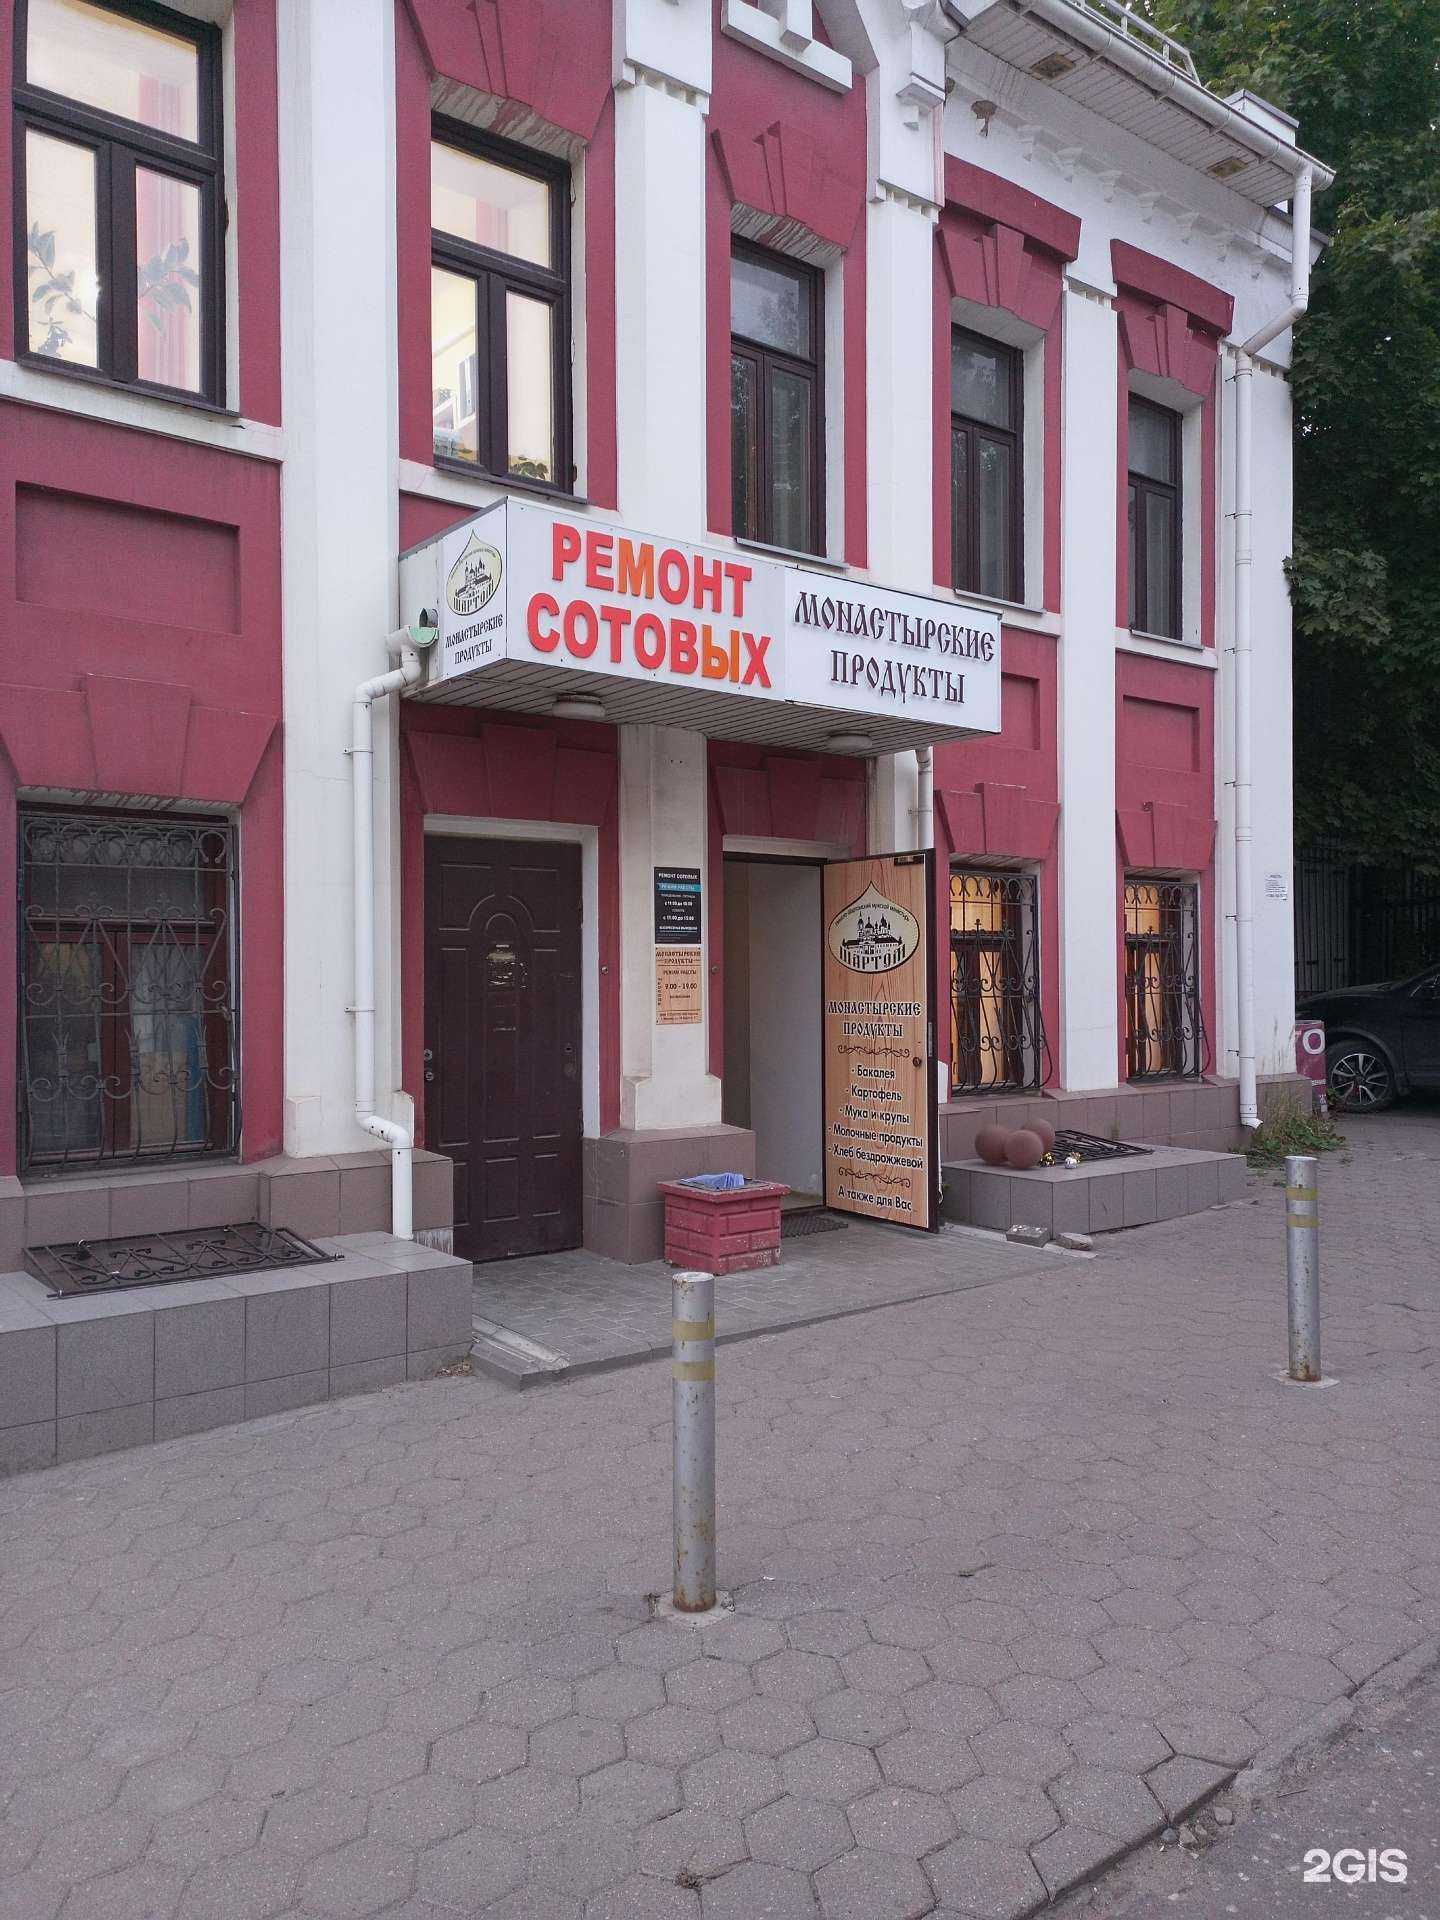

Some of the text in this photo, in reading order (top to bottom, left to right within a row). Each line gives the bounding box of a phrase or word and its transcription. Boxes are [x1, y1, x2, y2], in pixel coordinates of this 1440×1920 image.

[552, 522, 752, 618] РЕМОНТ
[445, 614, 503, 648] МОНАСТЫРСКИЕ
[794, 591, 995, 663] МОНАСТЫРСКИЕ
[454, 639, 492, 664] ПРОДУКТЫ
[527, 592, 772, 688] СОТОВЫХ
[830, 649, 966, 704] ПРОДУКТЫ
[828, 1001, 921, 1016] МОНАСТЫРСКИЕ
[843, 1022, 903, 1038] ПРОДУКТЫ
[857, 1065, 895, 1079] Бакалея
[851, 1085, 902, 1103] Картофель
[845, 1105, 868, 1120] Мука
[879, 1111, 909, 1125] крупы
[833, 1124, 923, 1148] Молочные продукты
[833, 1144, 923, 1169] Хлеб бездрожжевой
[838, 1186, 912, 1211] А также для Вас
